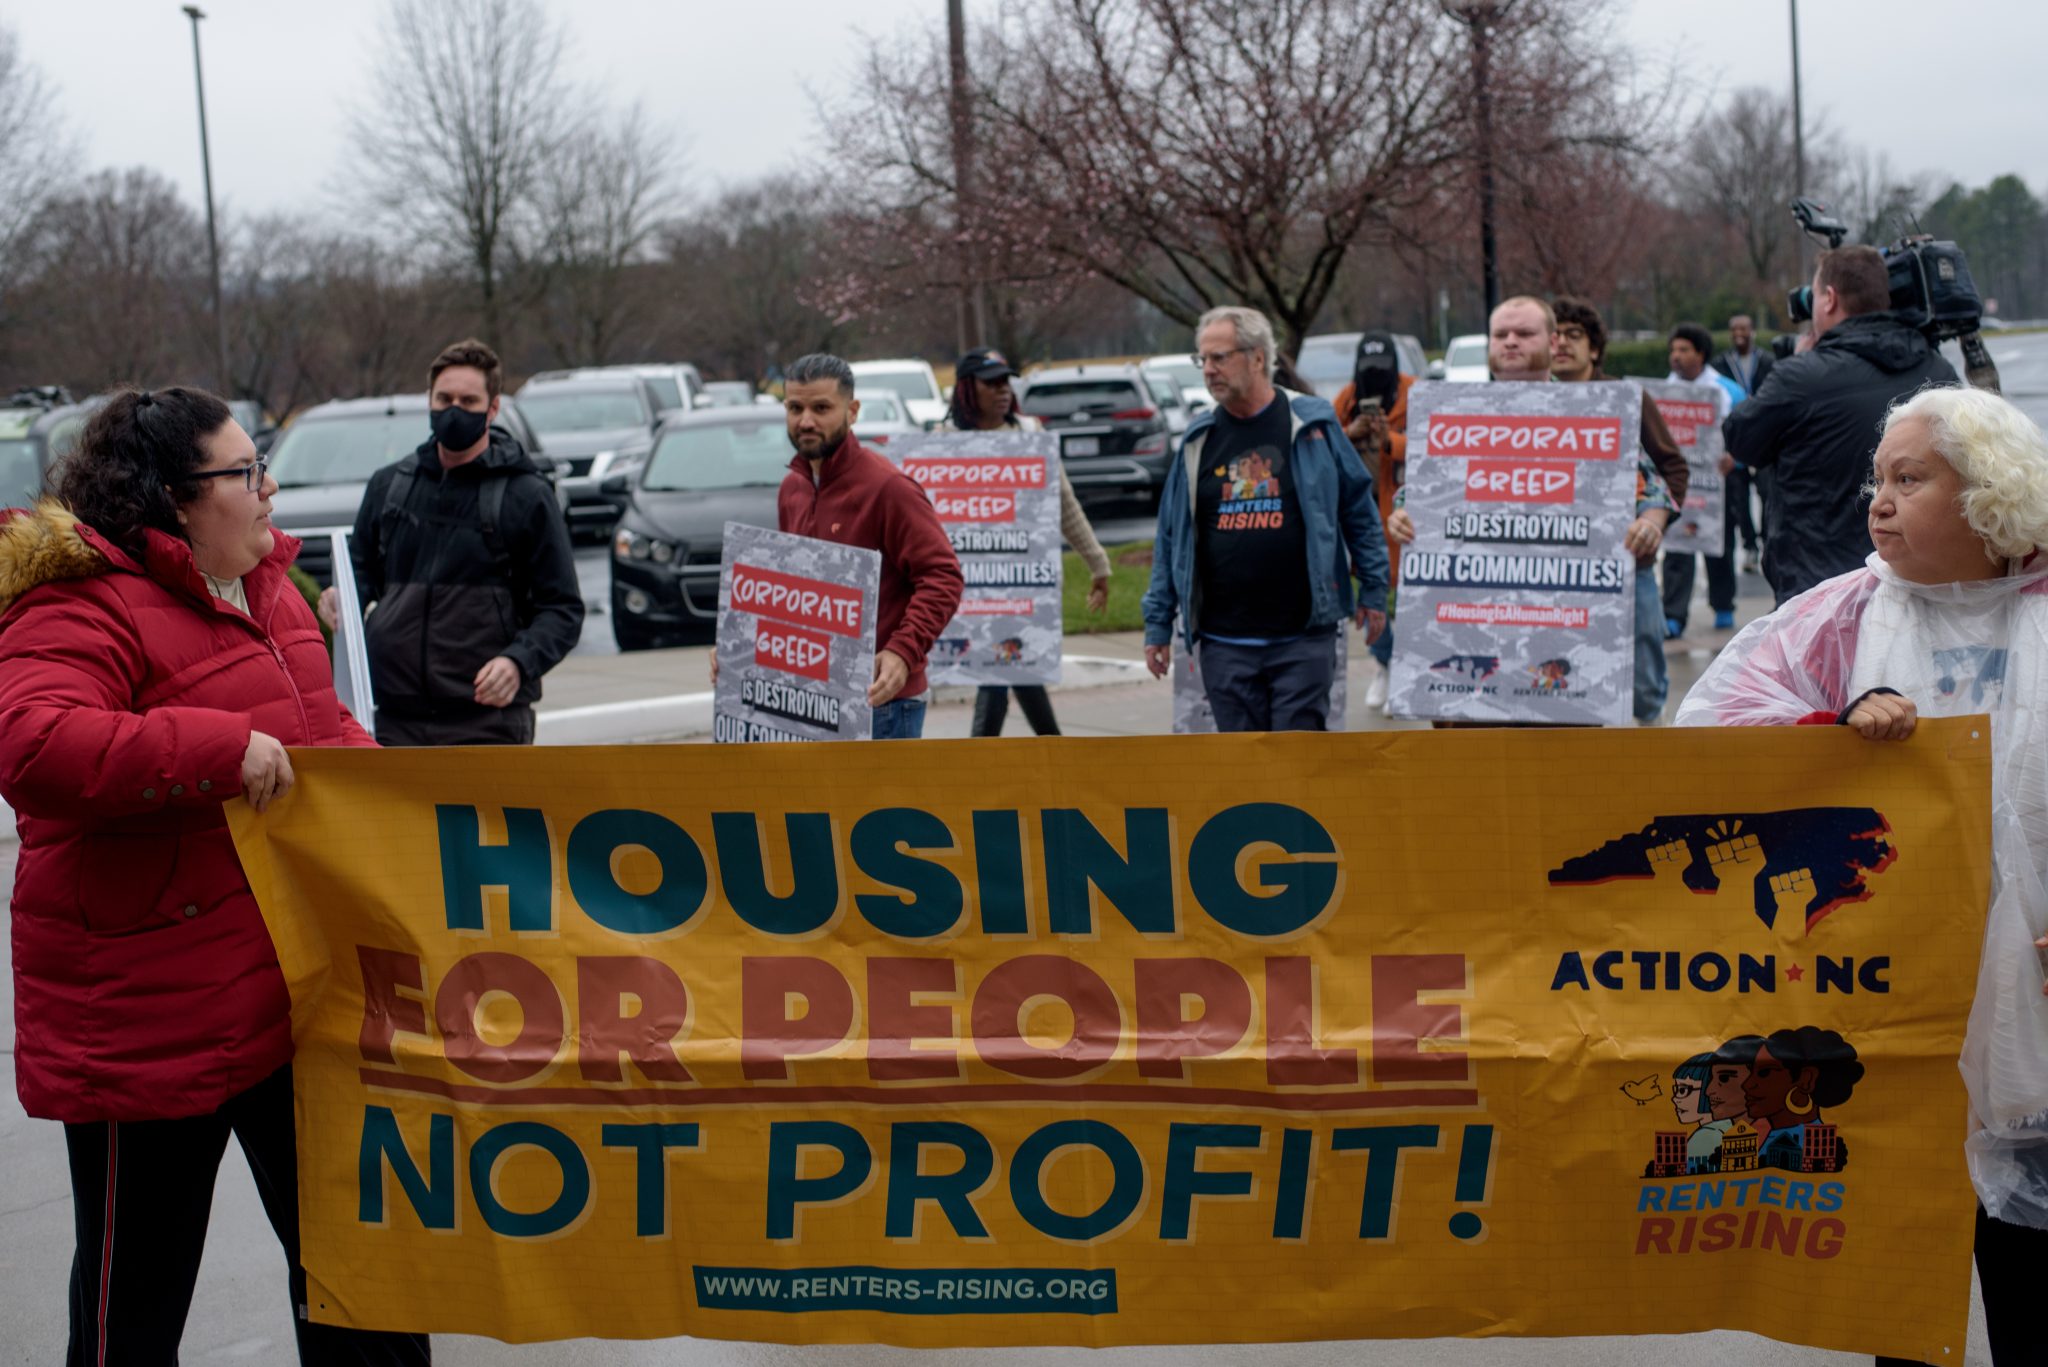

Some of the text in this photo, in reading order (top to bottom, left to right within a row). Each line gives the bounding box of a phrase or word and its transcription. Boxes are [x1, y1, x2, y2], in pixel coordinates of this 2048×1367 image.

[1428, 422, 1616, 452] CORPORATE
[1467, 468, 1570, 496] GREED
[935, 496, 1012, 518] GREED
[1217, 512, 1284, 529] RISING
[1218, 499, 1282, 513] RENTERS
[1446, 513, 1588, 541] IS DESTROYING
[1404, 552, 1624, 588] OUR COMMUNITIES!
[732, 573, 861, 628] CORPORATE
[756, 631, 827, 667] GREED
[742, 679, 840, 725] IS DESTROYING
[1428, 683, 1498, 695] ACTION NC
[715, 715, 748, 743] OUR
[435, 802, 1346, 944] HOUSING
[1550, 951, 1891, 994] ACTION NC
[355, 944, 1477, 1088] FOR PEOPLE
[357, 1104, 1496, 1247] NOT PROFIT!
[1636, 1176, 1846, 1213] RENTERS
[1635, 1211, 1847, 1260] RISING
[704, 1276, 1108, 1300] WWW.RENTERS-RISING.ORG
